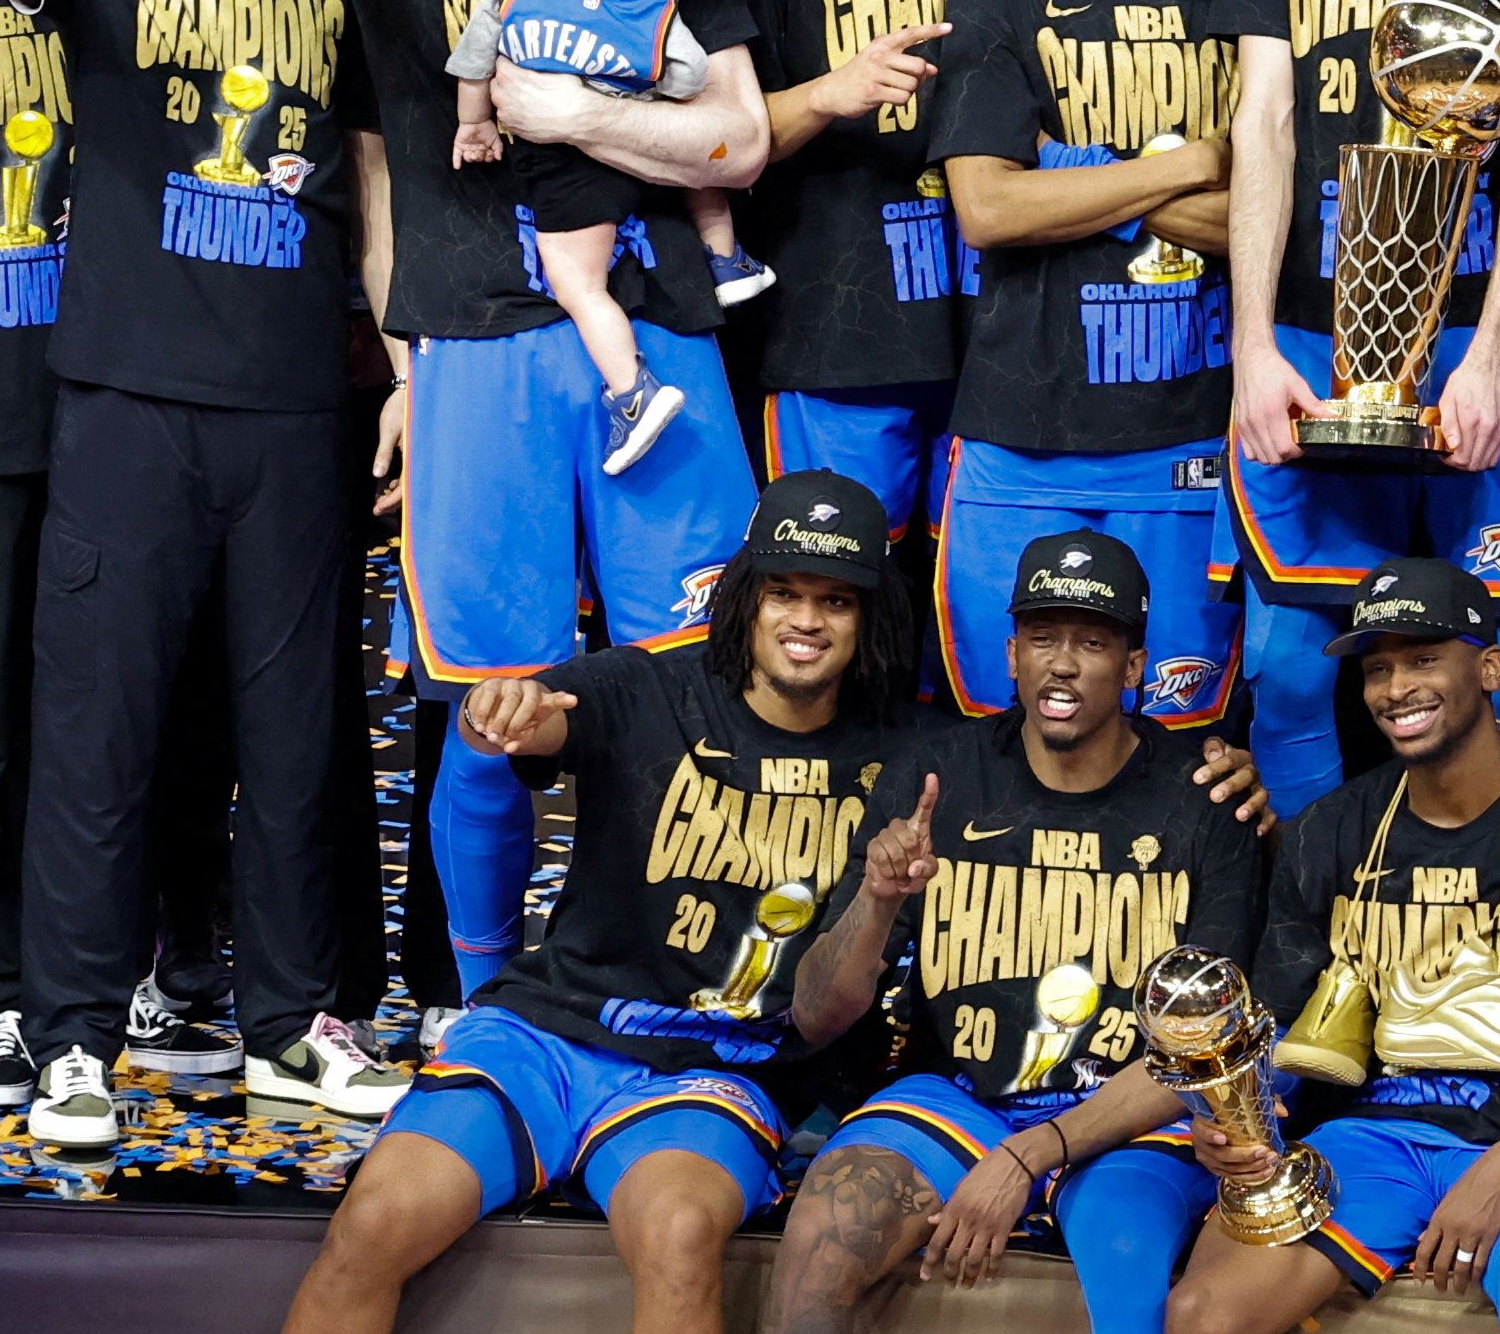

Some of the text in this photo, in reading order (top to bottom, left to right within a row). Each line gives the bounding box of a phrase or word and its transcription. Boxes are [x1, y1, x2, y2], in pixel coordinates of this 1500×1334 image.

[1114, 6, 1186, 40] NBA
[502, 20, 637, 77] ARTENST
[1320, 58, 1357, 113] 20
[167, 76, 306, 150] 20 25
[167, 172, 270, 202] OKLAHOMA
[161, 185, 307, 267] THUNDER
[1080, 282, 1198, 302] OKLAHOM
[774, 519, 860, 553] Champions
[1029, 570, 1114, 598] Champions
[1355, 598, 1425, 624] Champions
[1163, 667, 1204, 694] OKC
[761, 758, 829, 795] NBA
[1031, 829, 1100, 870] NBA
[1413, 867, 1478, 903] NBA
[666, 894, 716, 953] 20
[920, 857, 1190, 1000] CHAMPIONS
[954, 1005, 1138, 1062] 20 25
